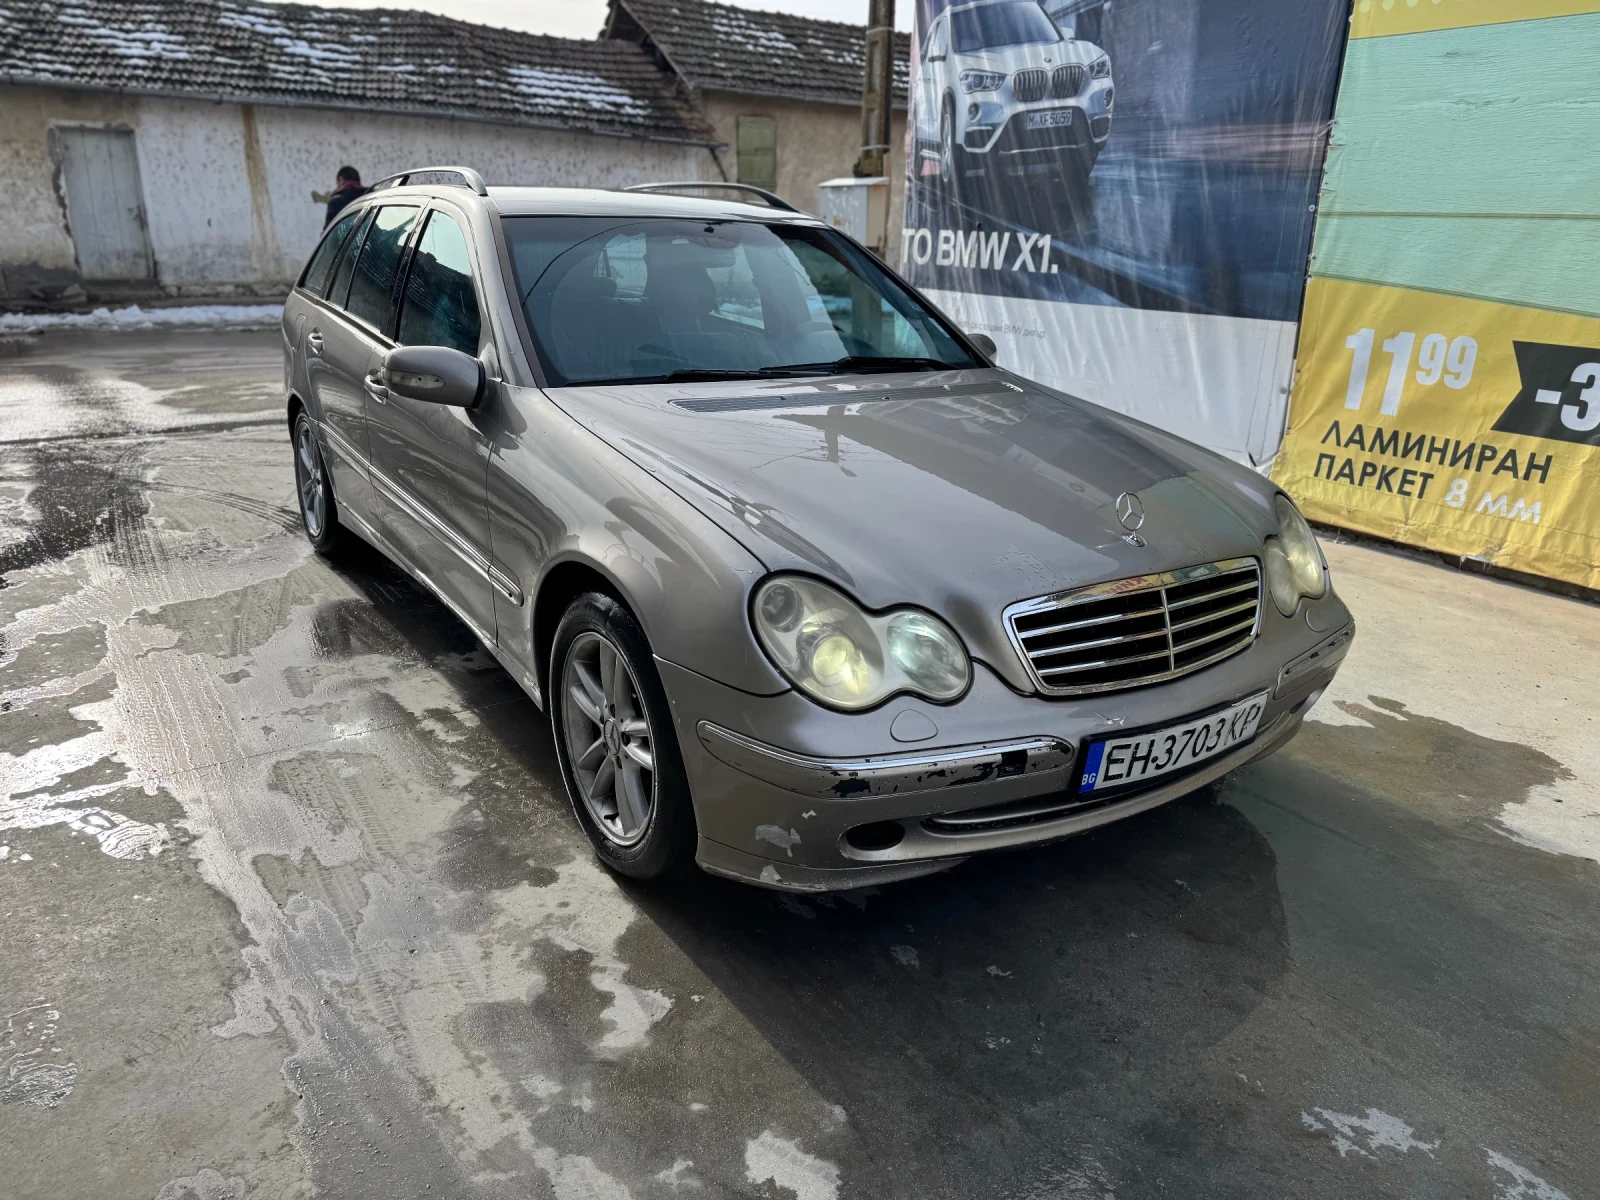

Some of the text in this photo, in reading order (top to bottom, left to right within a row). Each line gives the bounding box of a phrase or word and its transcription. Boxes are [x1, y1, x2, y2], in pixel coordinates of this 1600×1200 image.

[936, 229, 1011, 270] BMW
[1011, 232, 1059, 274] X1.
[1003, 324, 1022, 335] BMW
[1320, 420, 1553, 484] ЛАМИНИРАН
[1313, 453, 1434, 499] ПАРКЕТ
[1445, 478, 1468, 508] 8
[1081, 772, 1096, 786] BG
